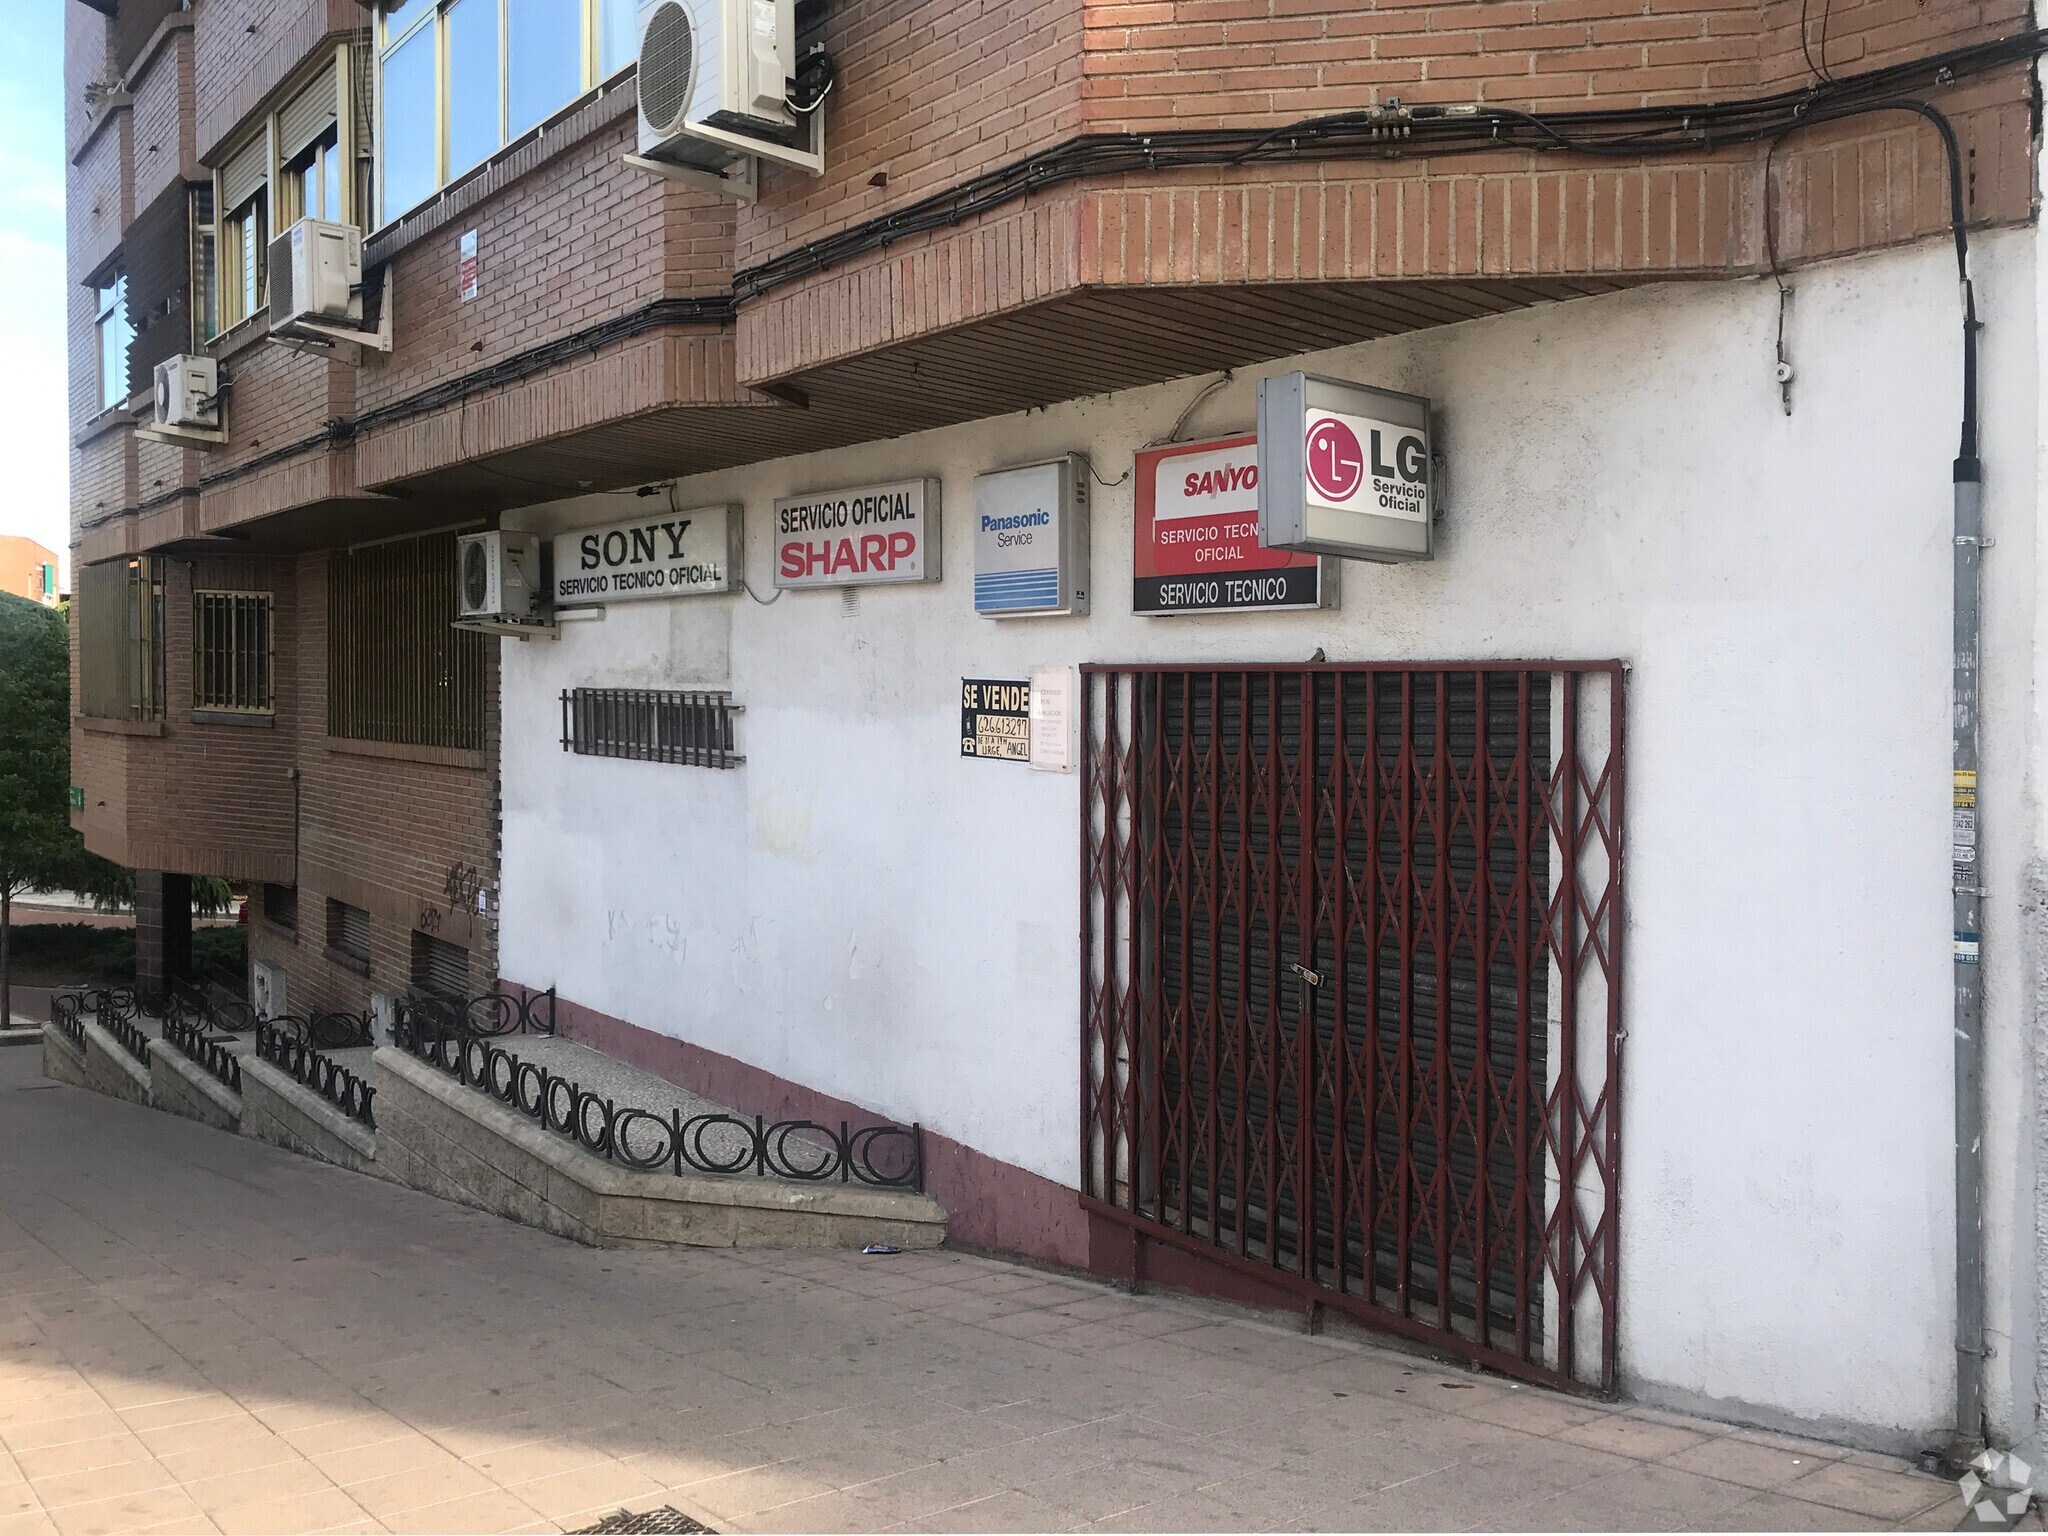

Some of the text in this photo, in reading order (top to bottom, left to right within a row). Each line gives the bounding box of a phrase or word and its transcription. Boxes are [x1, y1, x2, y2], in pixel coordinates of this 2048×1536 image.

[1371, 429, 1426, 484] LG
[1184, 463, 1258, 498] SANYO
[1373, 478, 1425, 499] Servicio
[780, 492, 916, 533] SERVICIO OFICIAL
[1378, 494, 1420, 513] Oficial
[981, 508, 1050, 532] Panasonic
[1160, 522, 1259, 544] SERVICIO TECN
[580, 520, 691, 570] SONY
[997, 530, 1033, 548] Service
[780, 531, 916, 578] SHARP
[1194, 546, 1244, 562] OFICIAL
[559, 563, 722, 596] SERVICIO TECNICO OFICIAL
[1159, 577, 1287, 605] SERVICIO TECNICO
[963, 684, 1029, 712] SE VENDE
